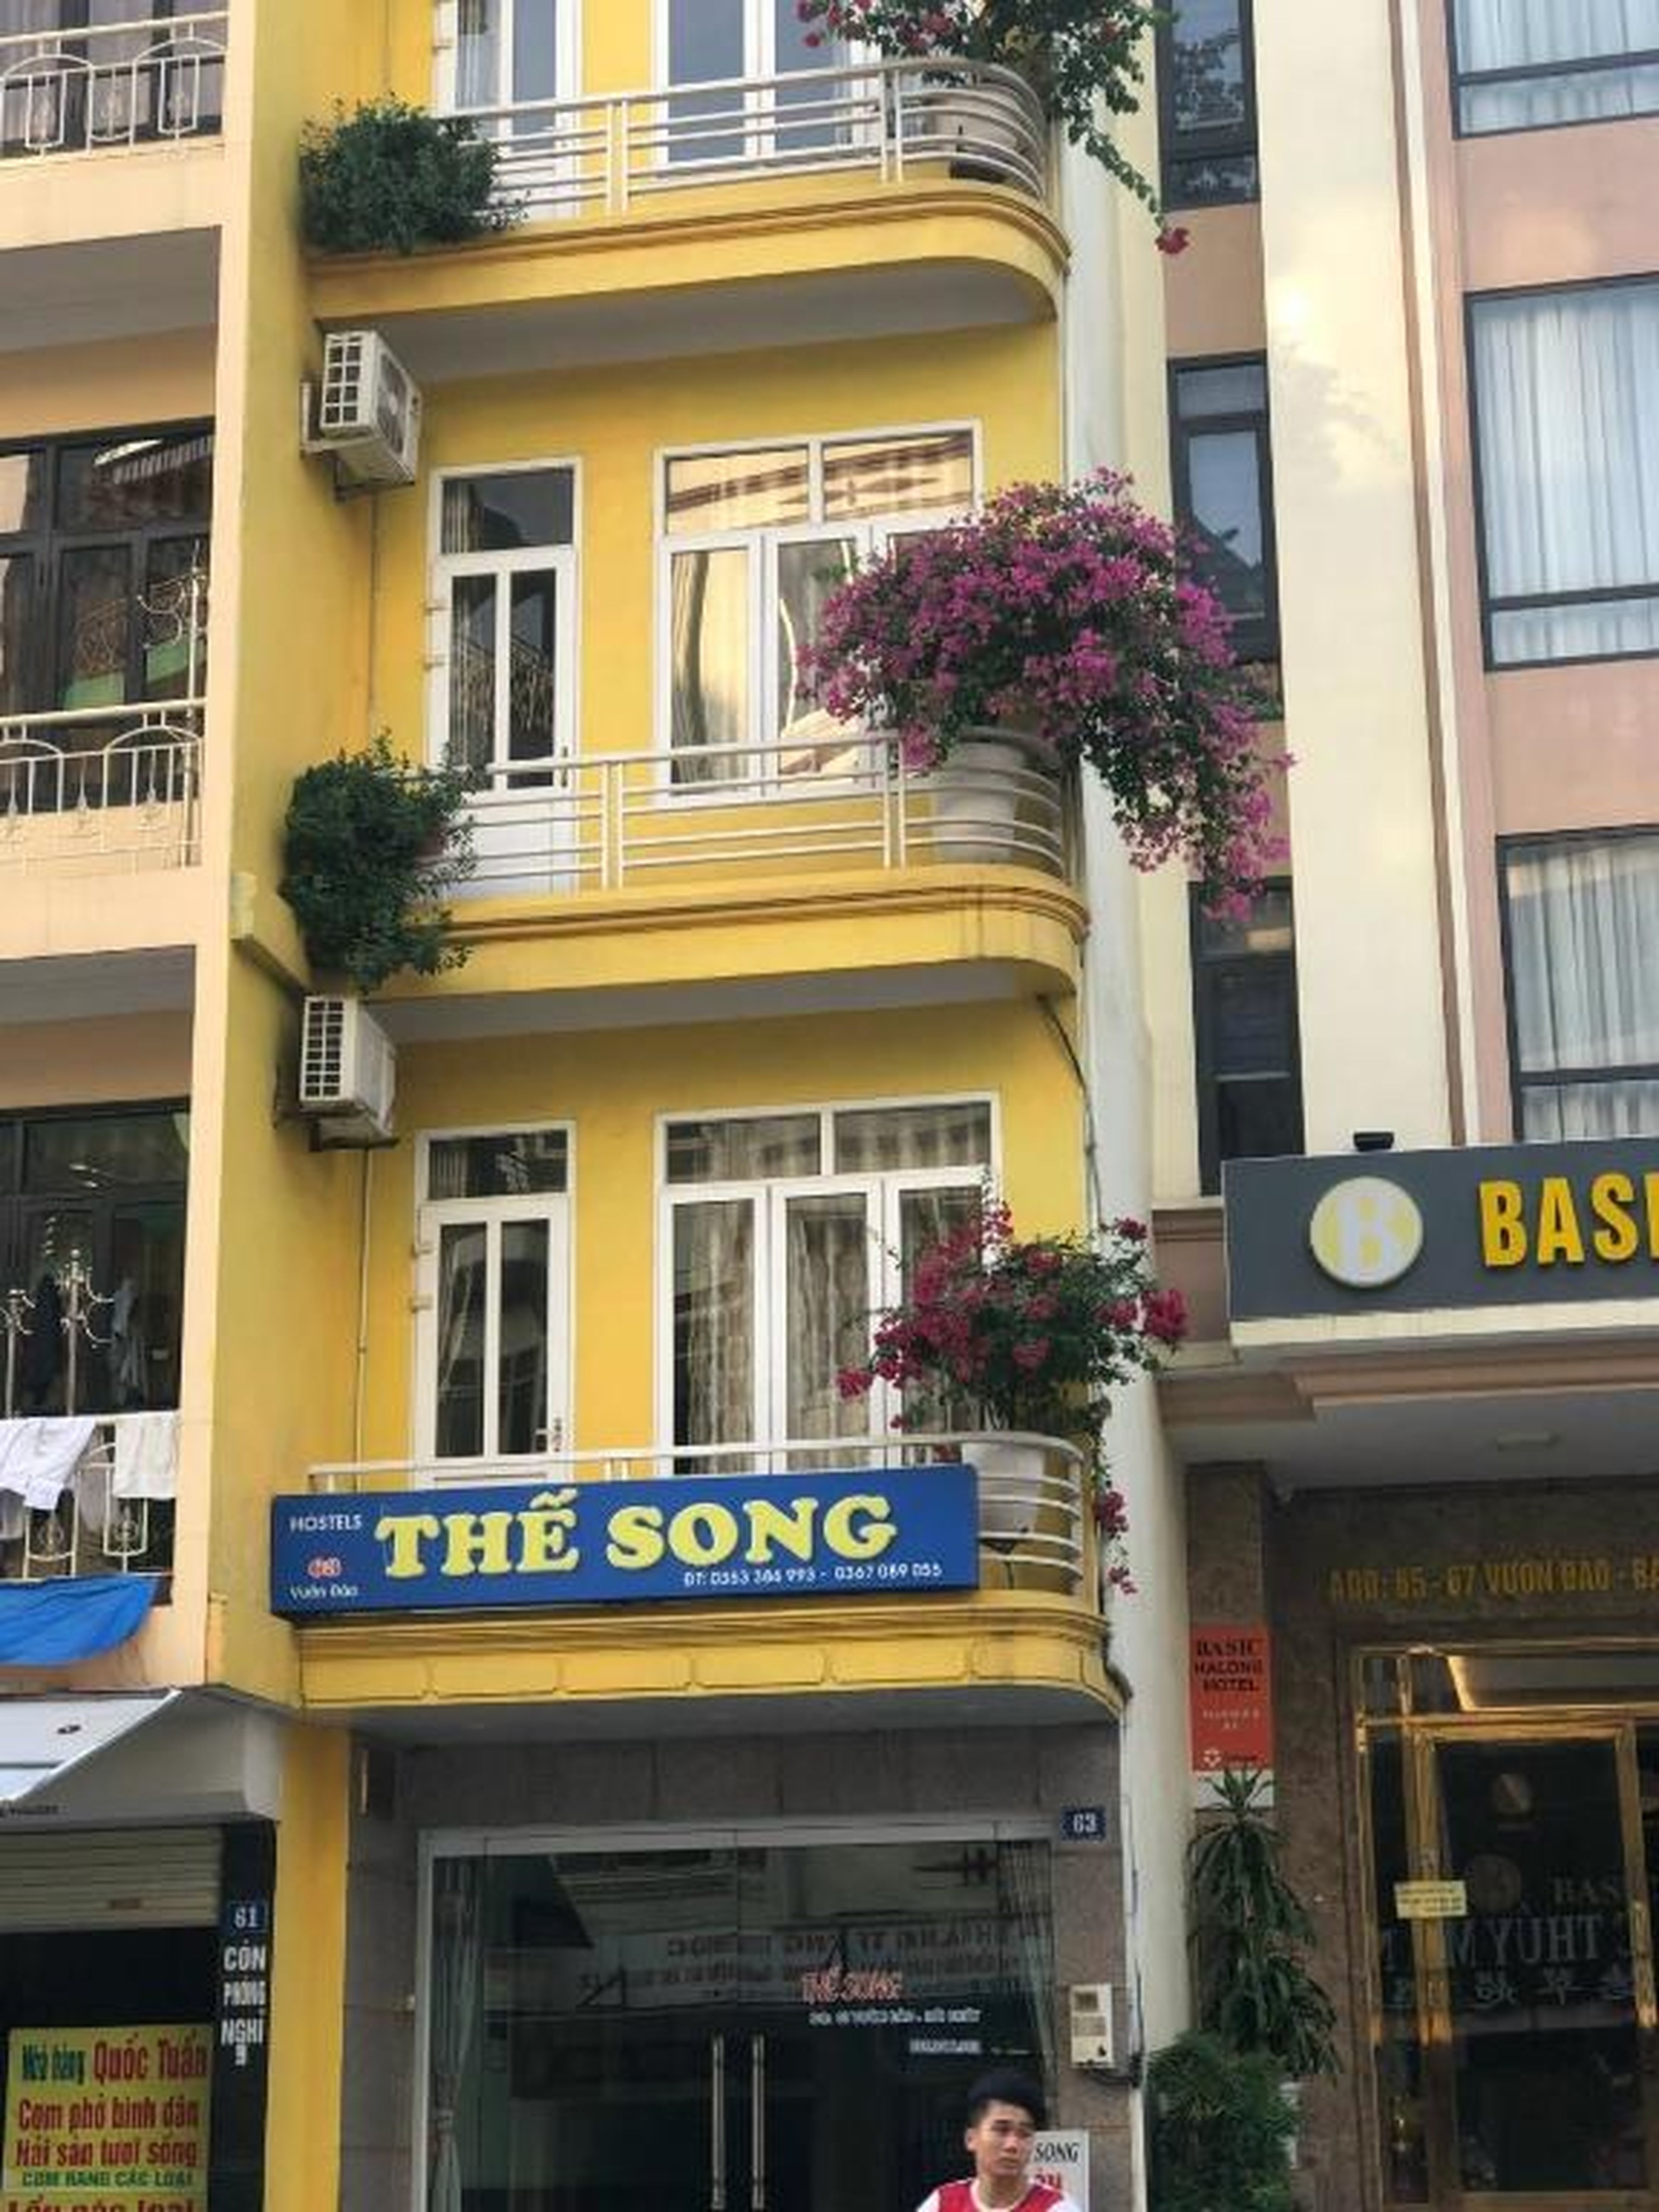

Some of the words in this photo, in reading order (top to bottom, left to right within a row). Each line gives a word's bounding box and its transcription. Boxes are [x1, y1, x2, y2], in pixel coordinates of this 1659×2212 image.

[290, 1513, 362, 1532] HOSTELS
[374, 1488, 579, 1578] THẾ
[607, 1494, 897, 1570] SONG
[1073, 1813, 1096, 1833] 63
[235, 1907, 257, 1928] 61
[93, 2031, 148, 2085] Quốc
